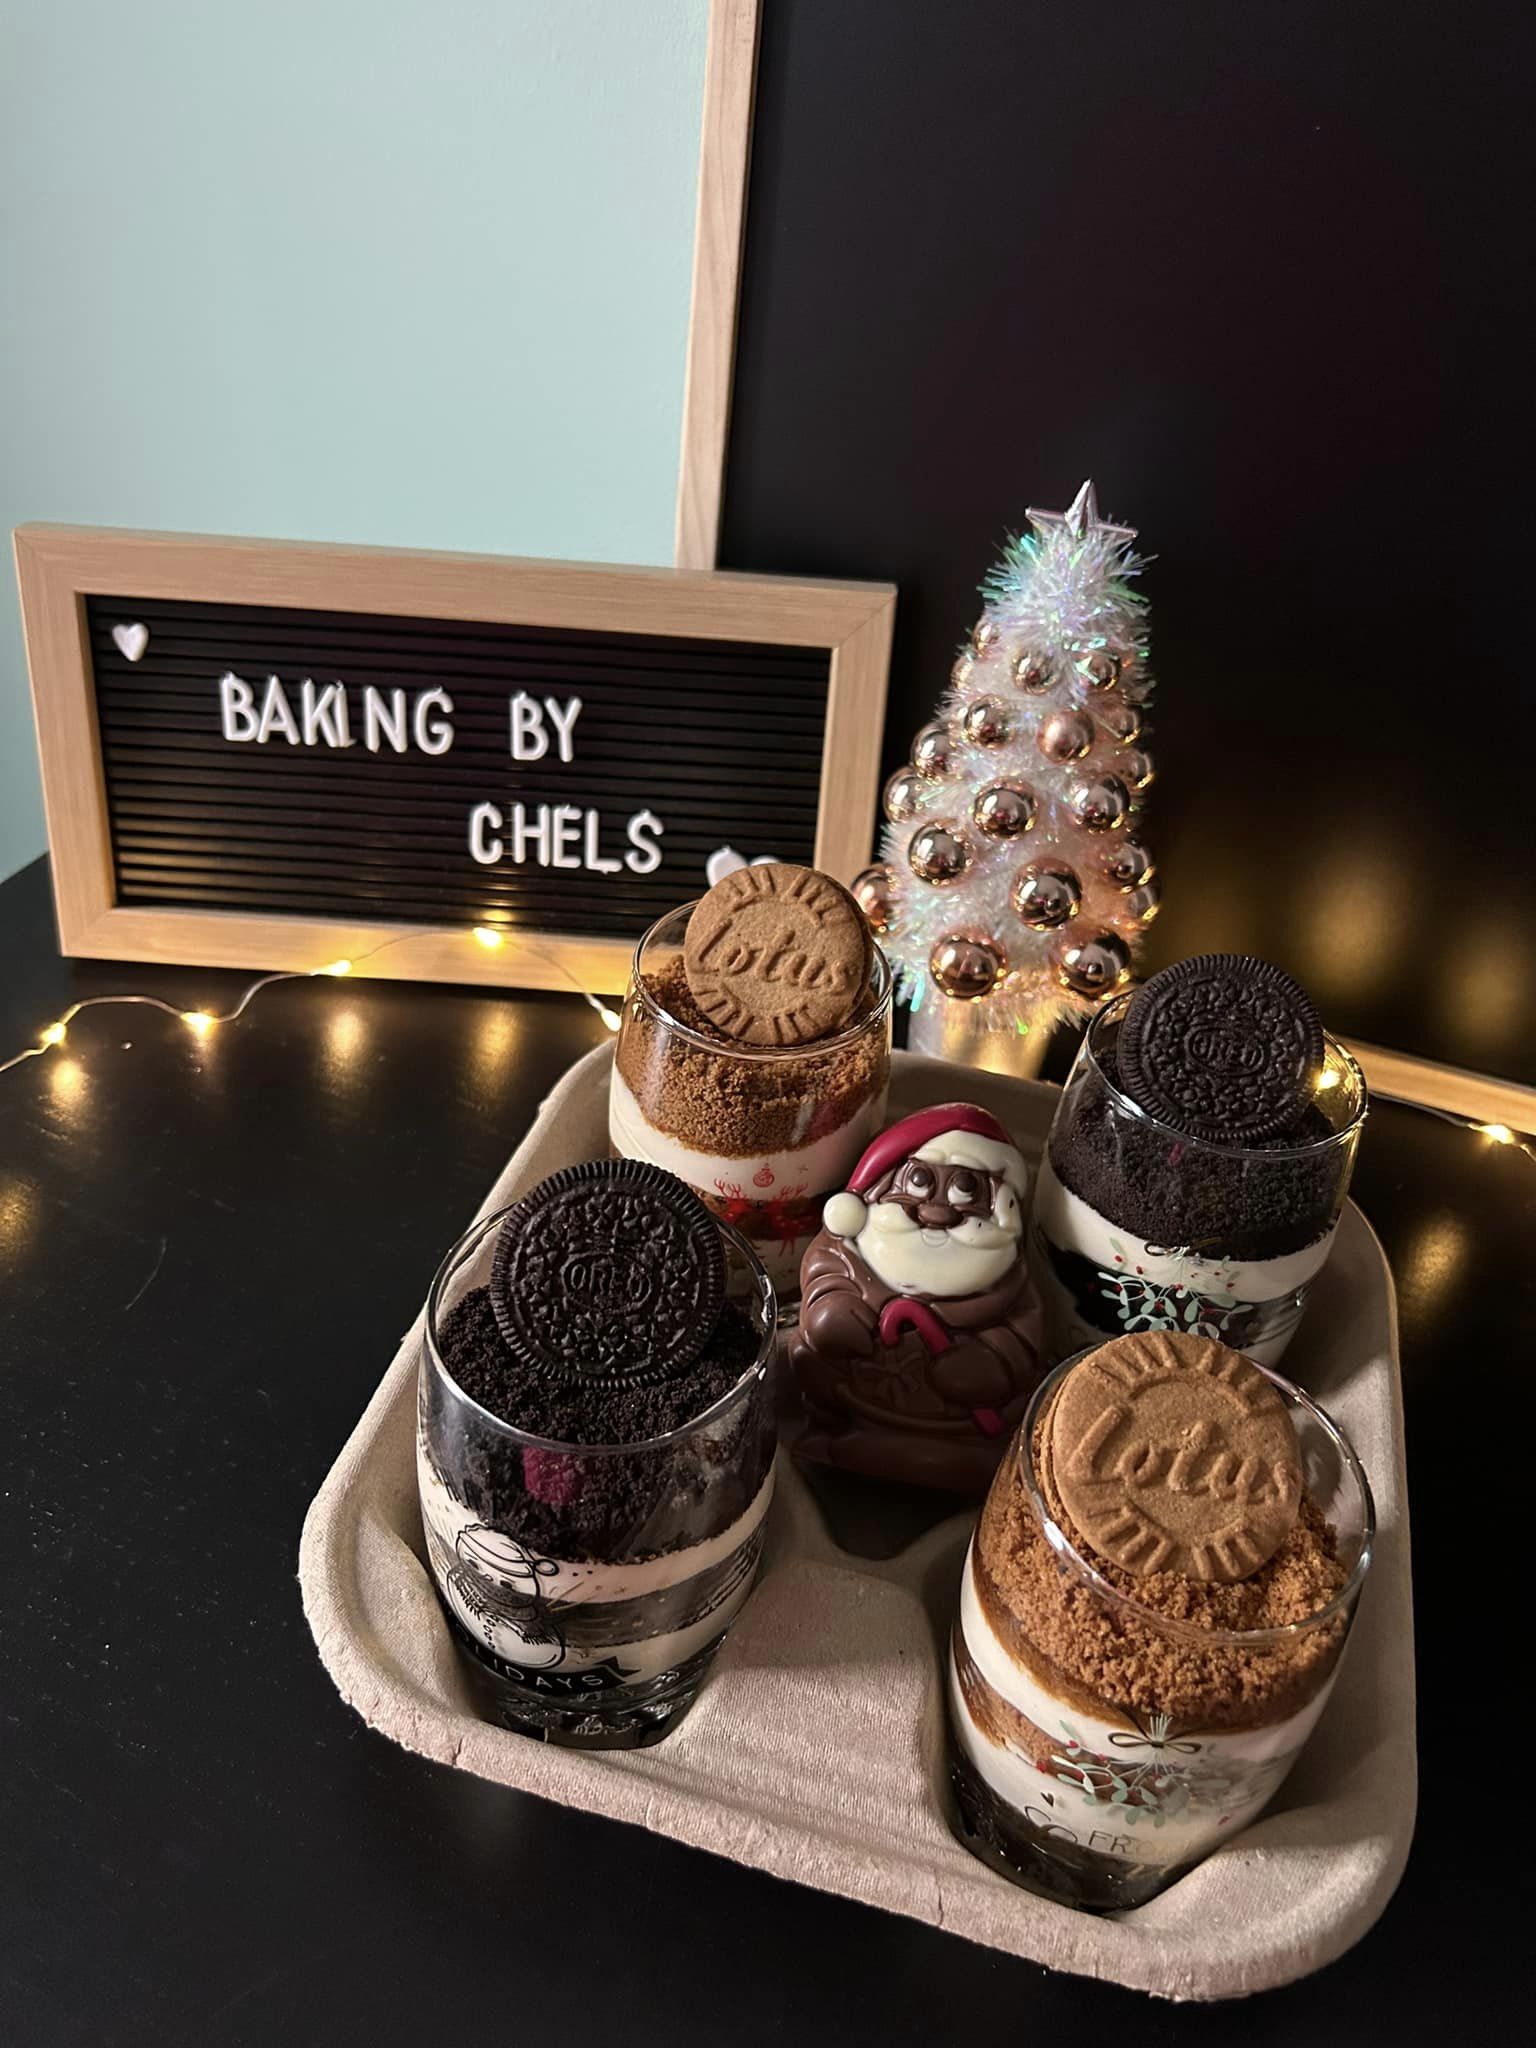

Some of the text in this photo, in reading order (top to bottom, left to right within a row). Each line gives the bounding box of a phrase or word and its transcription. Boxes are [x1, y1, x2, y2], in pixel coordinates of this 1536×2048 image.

[219, 671, 582, 763] BAKING BY
[469, 801, 664, 874] CHELS
[1064, 1402, 1290, 1506] Lotus
